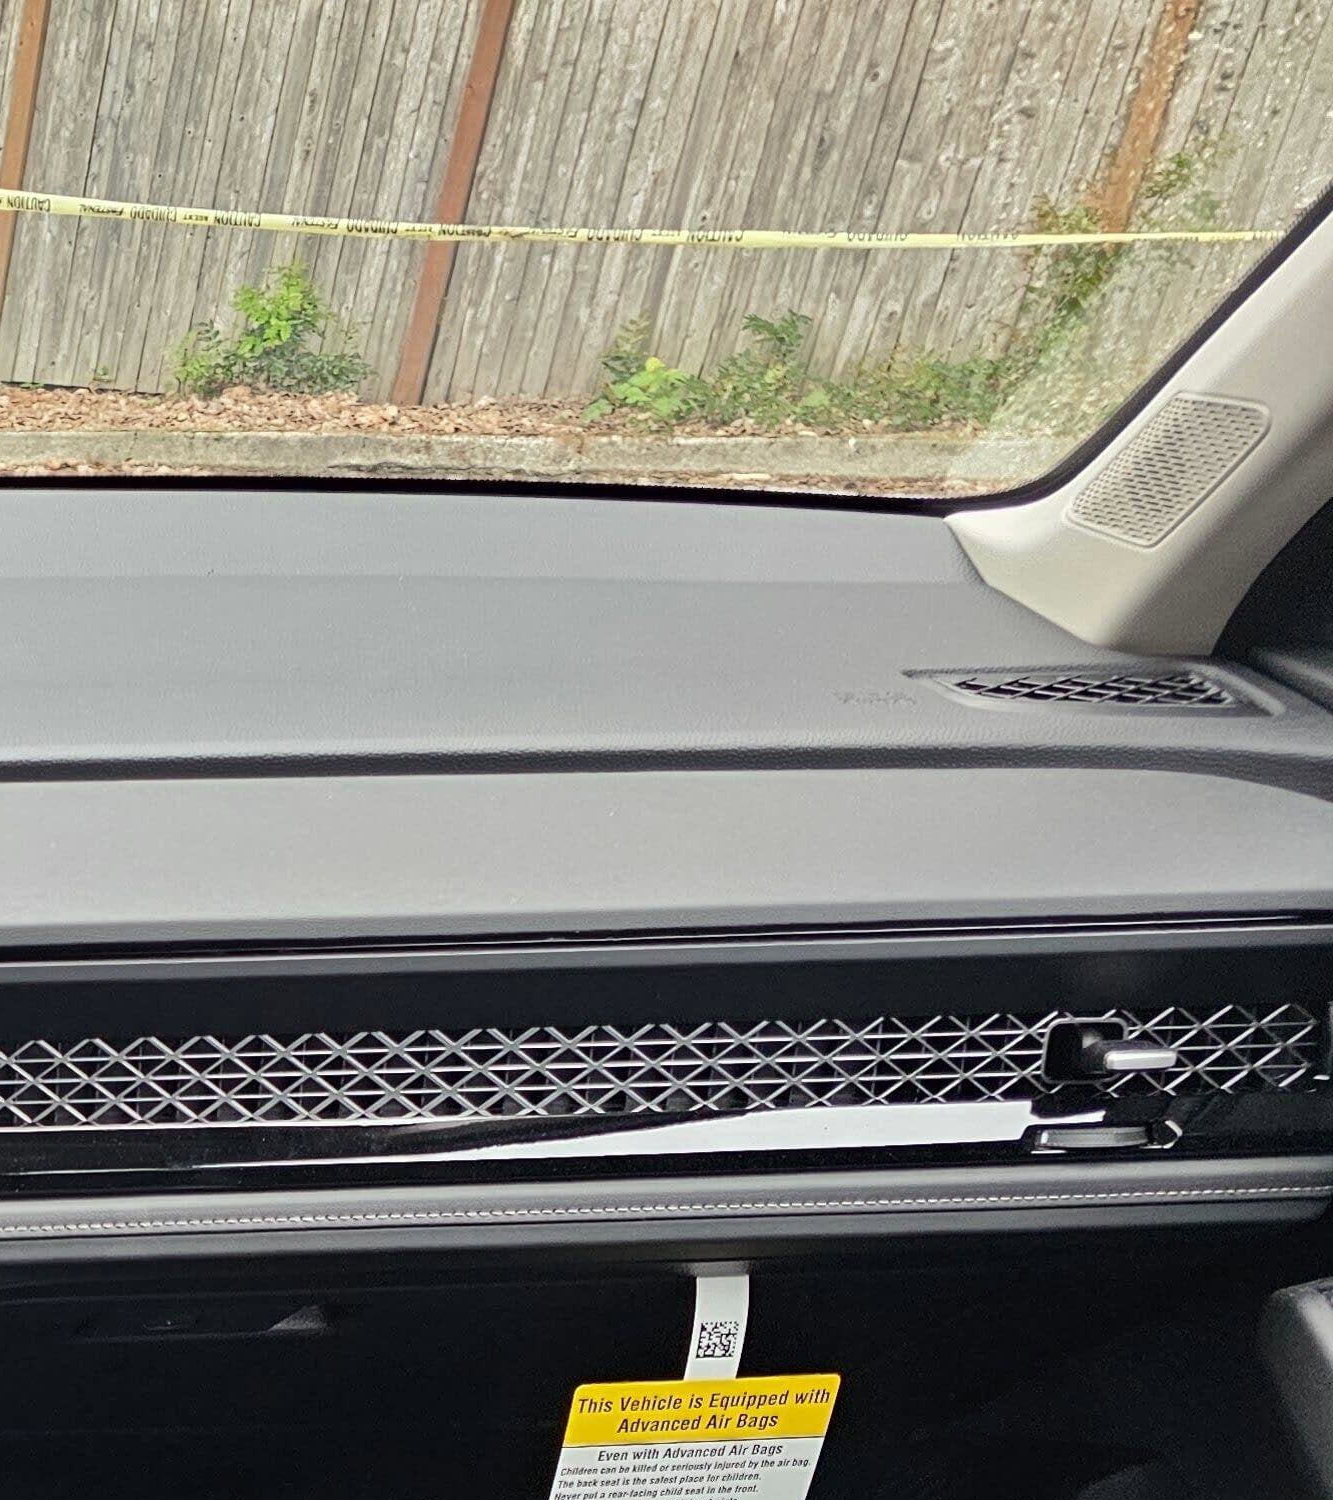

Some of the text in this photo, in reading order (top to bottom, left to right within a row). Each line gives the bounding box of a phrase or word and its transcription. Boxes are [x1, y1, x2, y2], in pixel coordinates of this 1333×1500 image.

[7, 195, 51, 212] CAUTION
[130, 206, 177, 223] CUIDADO
[213, 211, 262, 228] CAUTION
[578, 1389, 831, 1413] This Vehicle is Equipped with
[617, 1413, 779, 1433] Advanced Air Bags
[598, 1444, 783, 1461] Even with Advanced Air Bags
[560, 1465, 598, 1476] Children
[619, 1465, 630, 1474] be
[632, 1463, 657, 1473] killed
[672, 1462, 712, 1472] seriously
[714, 1460, 746, 1470] injured
[748, 1460, 758, 1469] by
[760, 1459, 775, 1468] the
[777, 1459, 791, 1467] air
[792, 1458, 811, 1468] bag.
[558, 1472, 762, 1489] The back seat is the safest place for children.
[554, 1493, 581, 1500] Never
[583, 1491, 598, 1500] put
[608, 1490, 658, 1499] rear-facing
[660, 1488, 682, 1497] child
[684, 1487, 705, 1496] seat
[707, 1486, 715, 1494] in
[718, 1485, 733, 1494] the
[734, 1484, 759, 1493] front.
